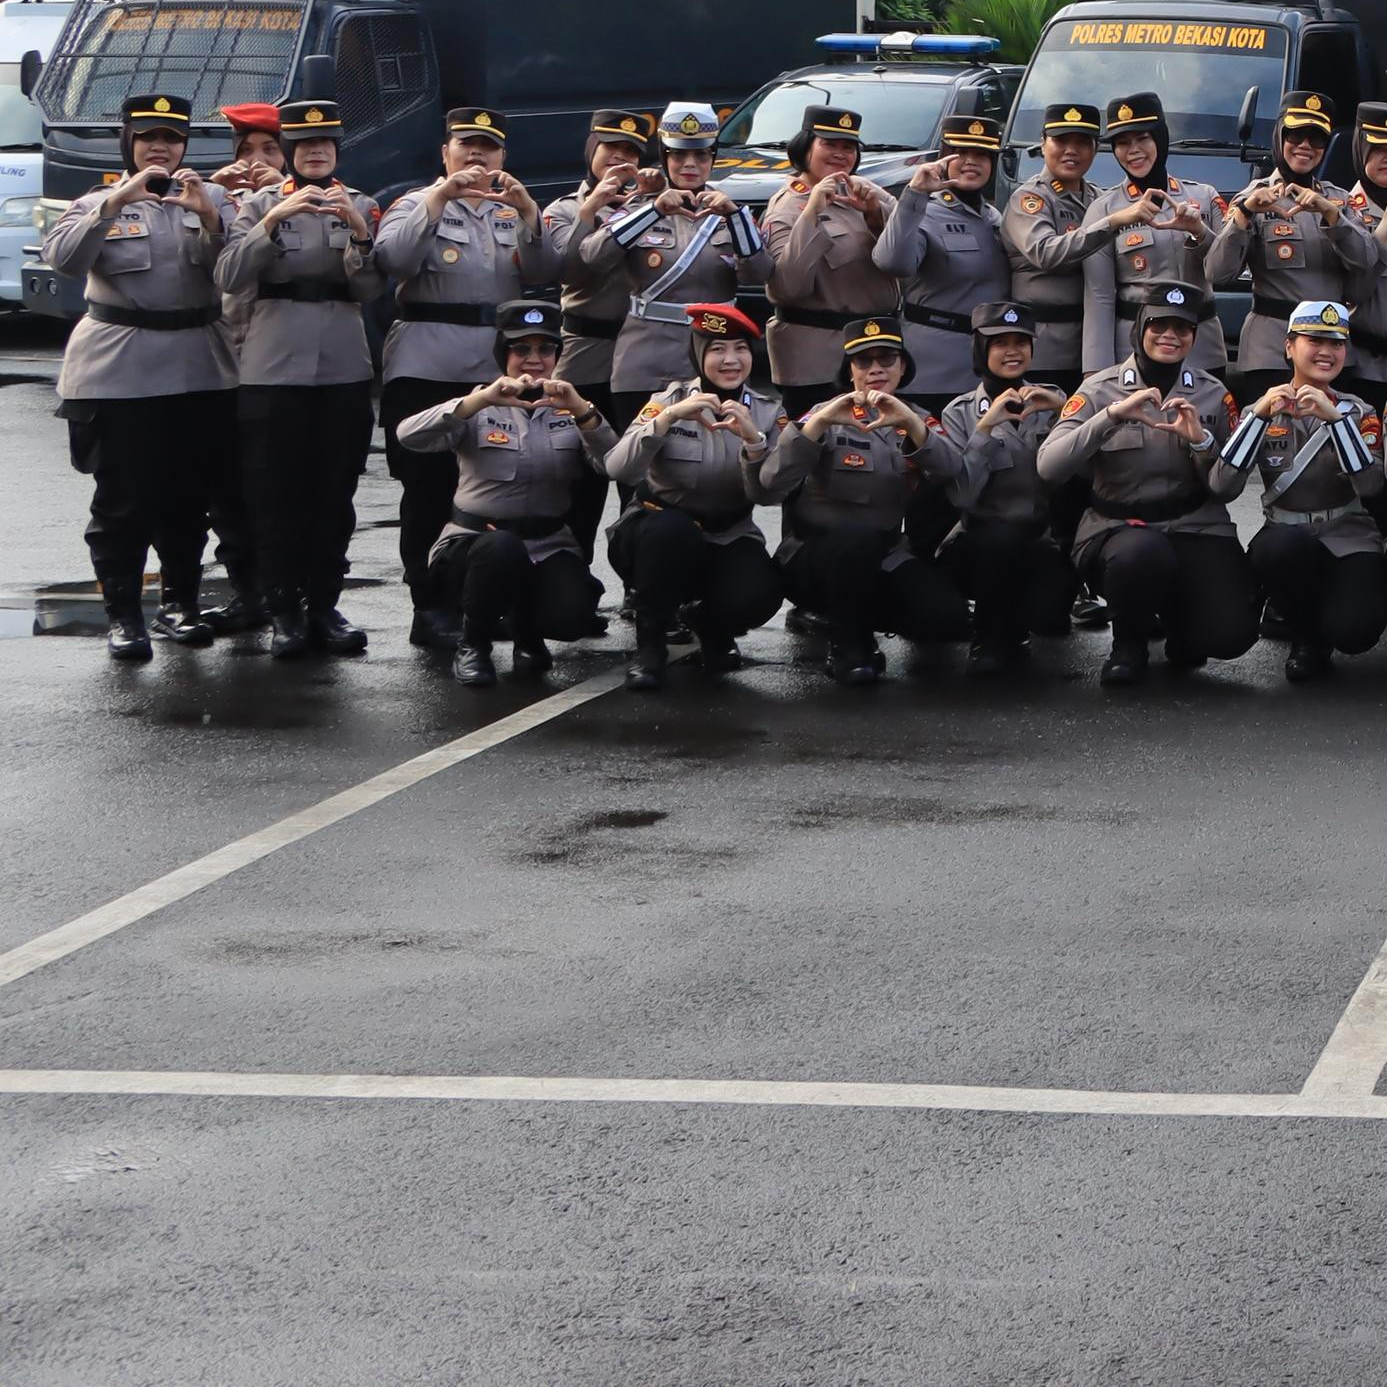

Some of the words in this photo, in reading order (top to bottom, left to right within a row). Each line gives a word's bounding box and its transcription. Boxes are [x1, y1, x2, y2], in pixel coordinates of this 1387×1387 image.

[1070, 23, 1123, 45] POLRES
[1123, 24, 1173, 45] METRO
[1173, 25, 1227, 47] BEKASI
[1227, 27, 1267, 50] KOTA
[549, 420, 576, 431] POL
